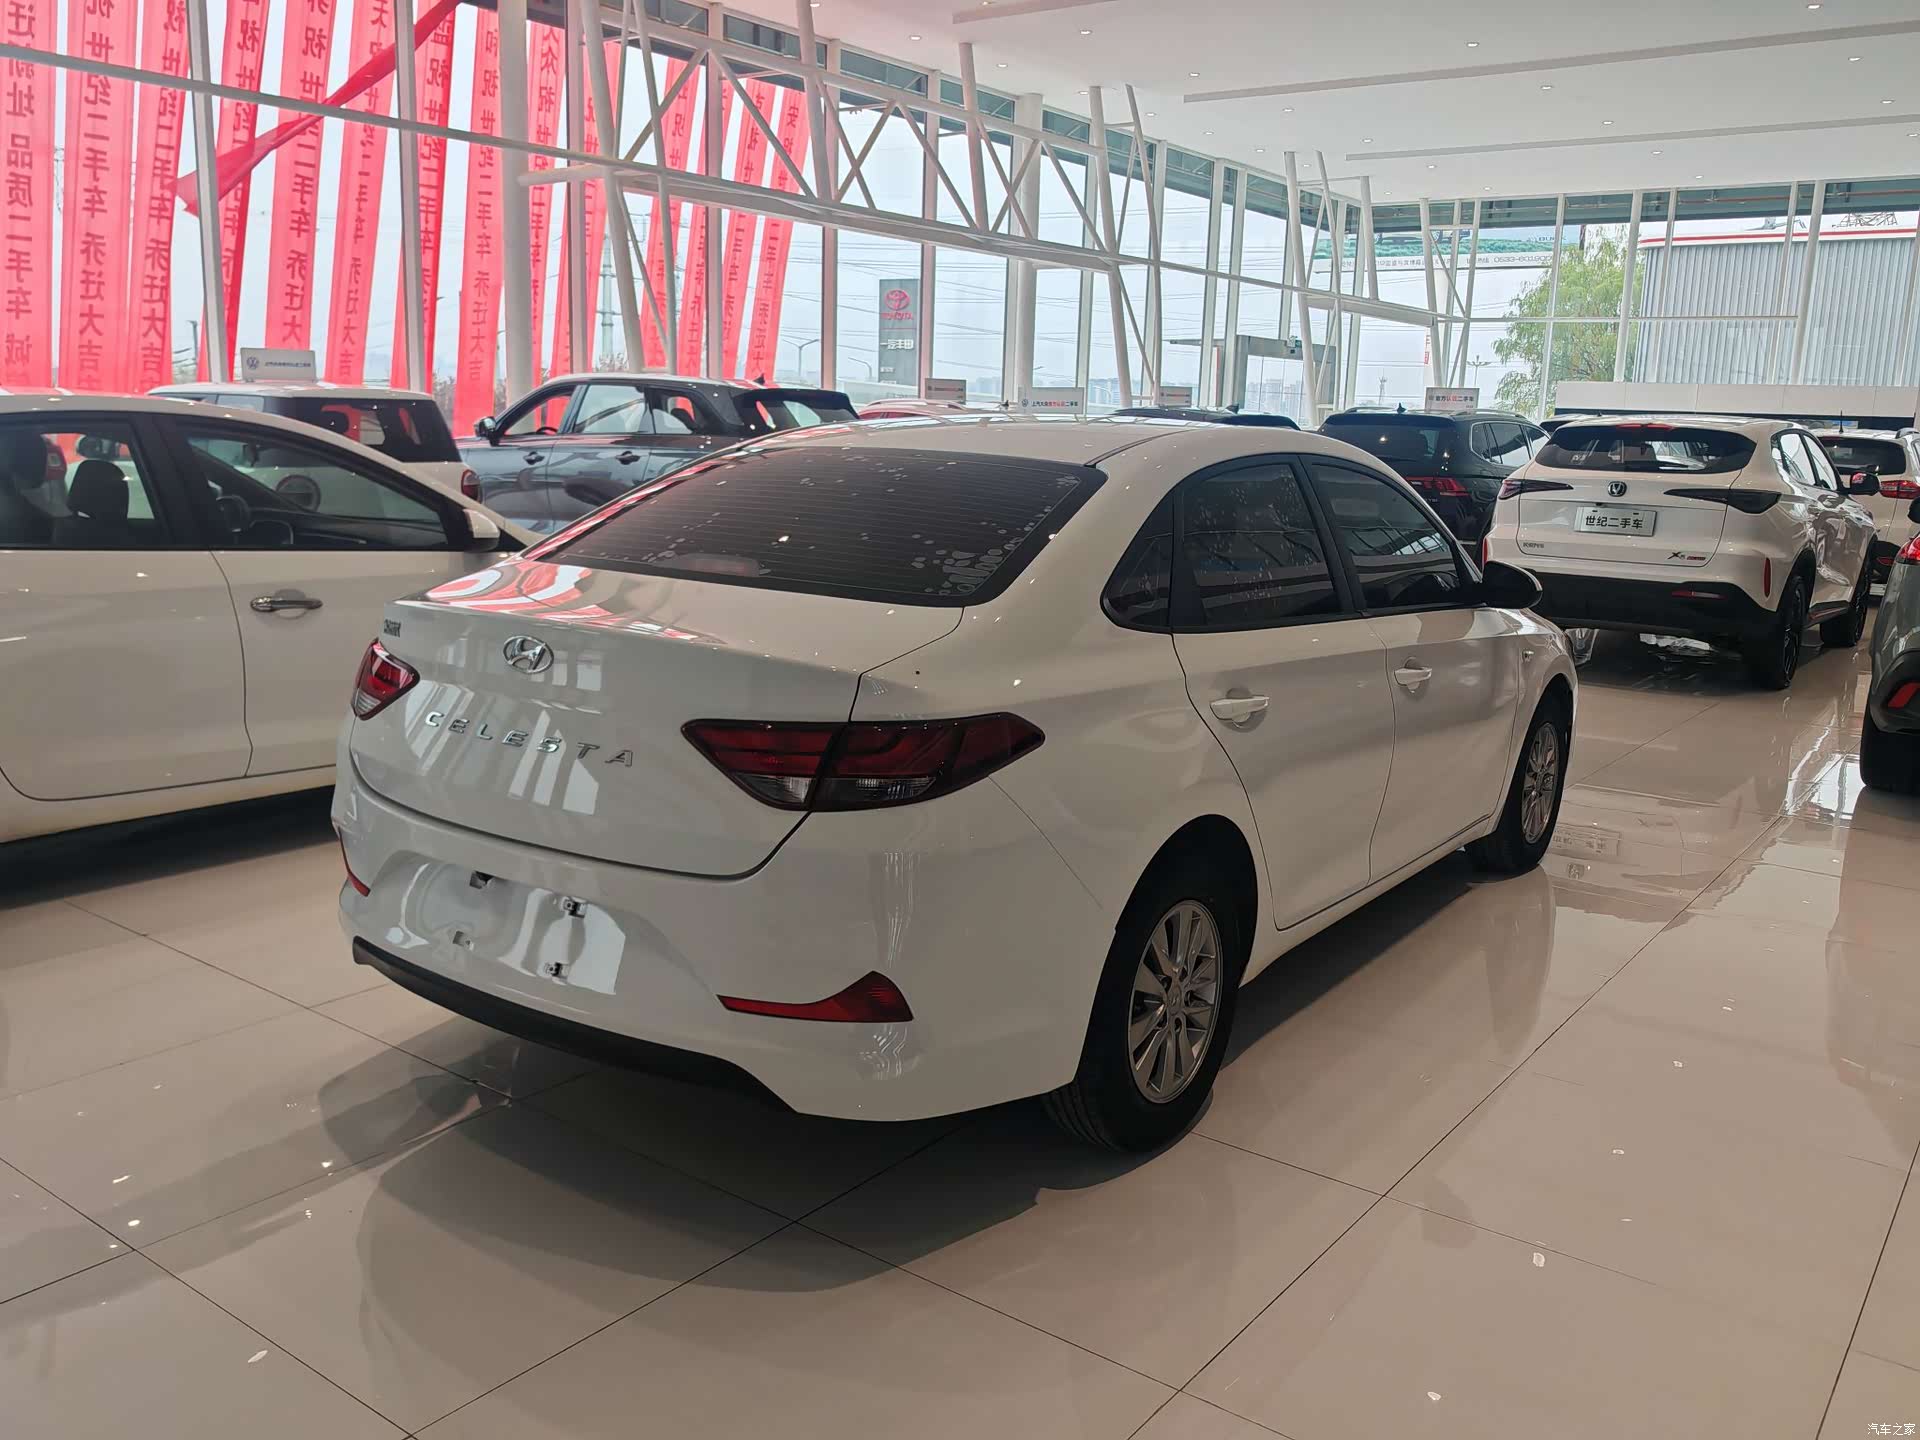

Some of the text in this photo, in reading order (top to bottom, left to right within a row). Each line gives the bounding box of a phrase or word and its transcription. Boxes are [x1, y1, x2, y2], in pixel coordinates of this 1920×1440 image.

[880, 339, 914, 350] 一汽丰田
[1585, 515, 1643, 529] 世纪二手车
[425, 711, 633, 767] CELESTA
